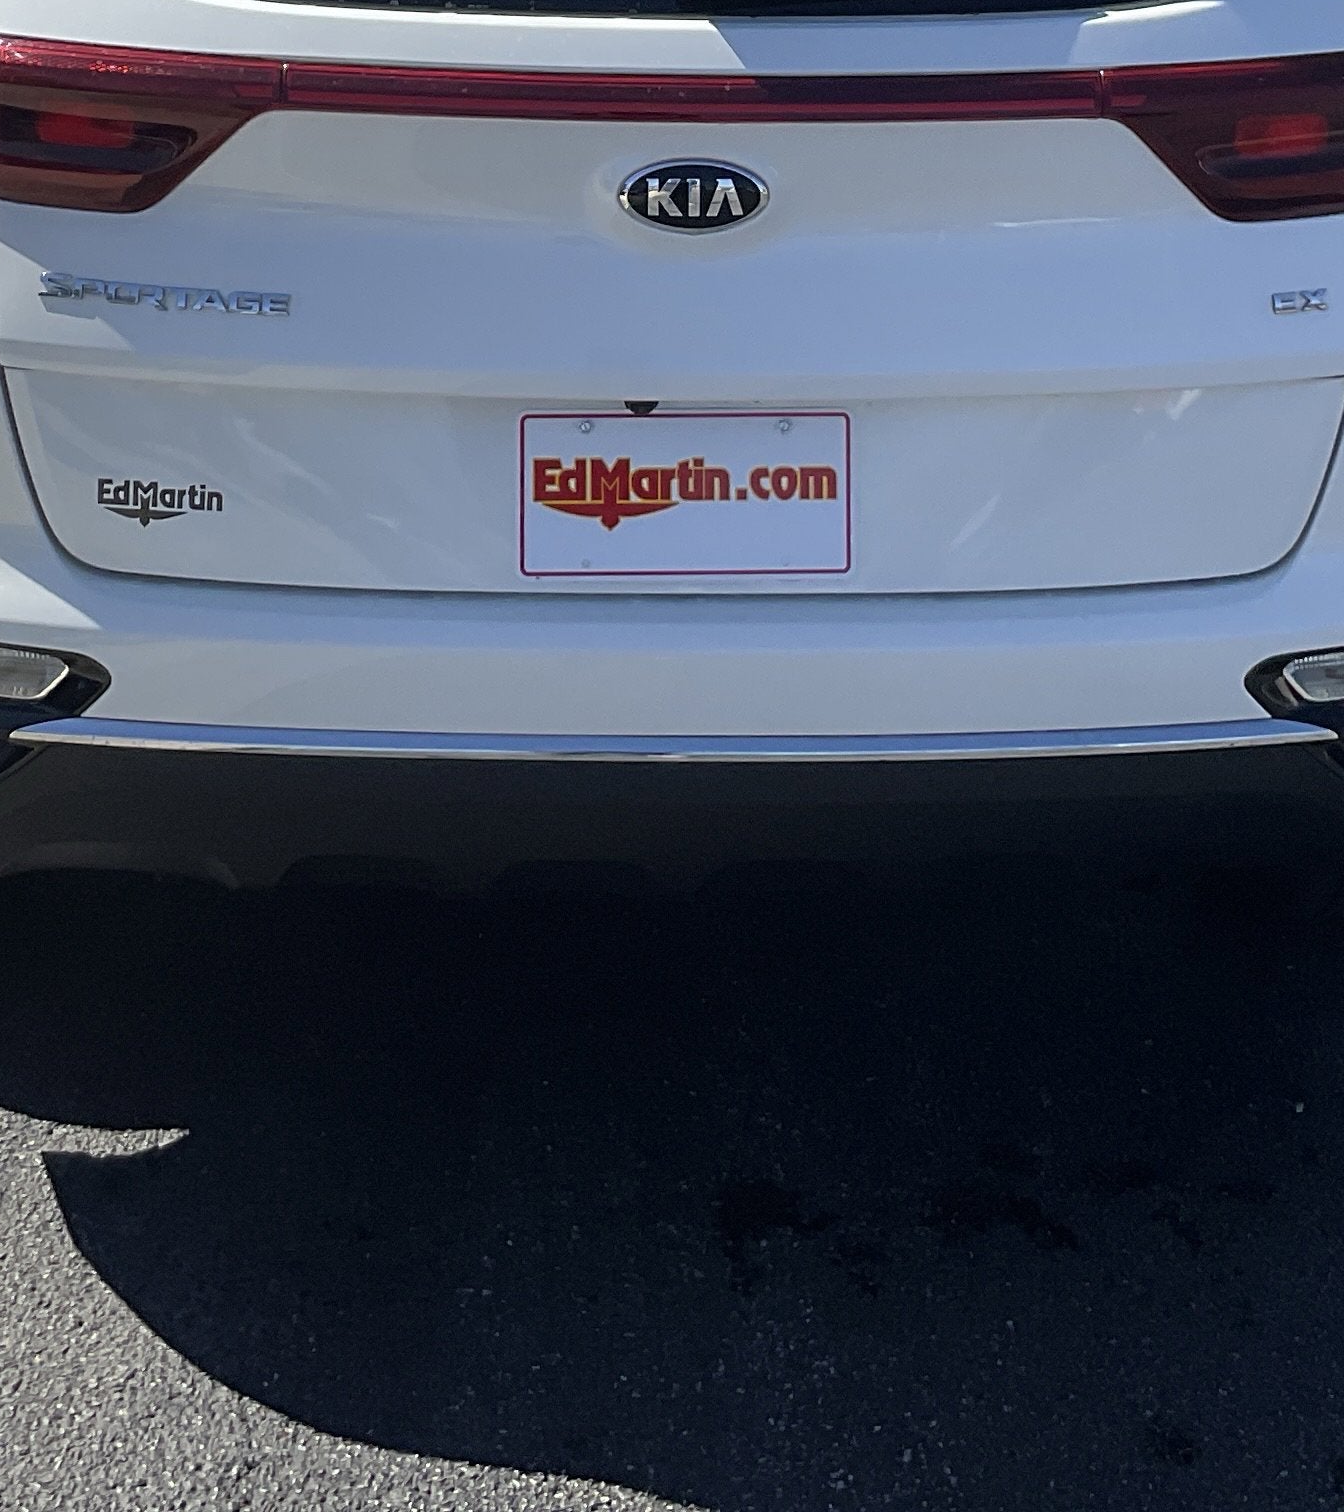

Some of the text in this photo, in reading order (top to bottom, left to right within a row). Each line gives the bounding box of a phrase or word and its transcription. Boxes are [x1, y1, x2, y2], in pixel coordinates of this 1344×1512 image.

[645, 177, 745, 218] KIA
[38, 271, 292, 317] SPORTAGE
[1271, 288, 1328, 315] EX
[97, 477, 224, 513] EdMartin
[532, 457, 839, 502] EdMartin.com
